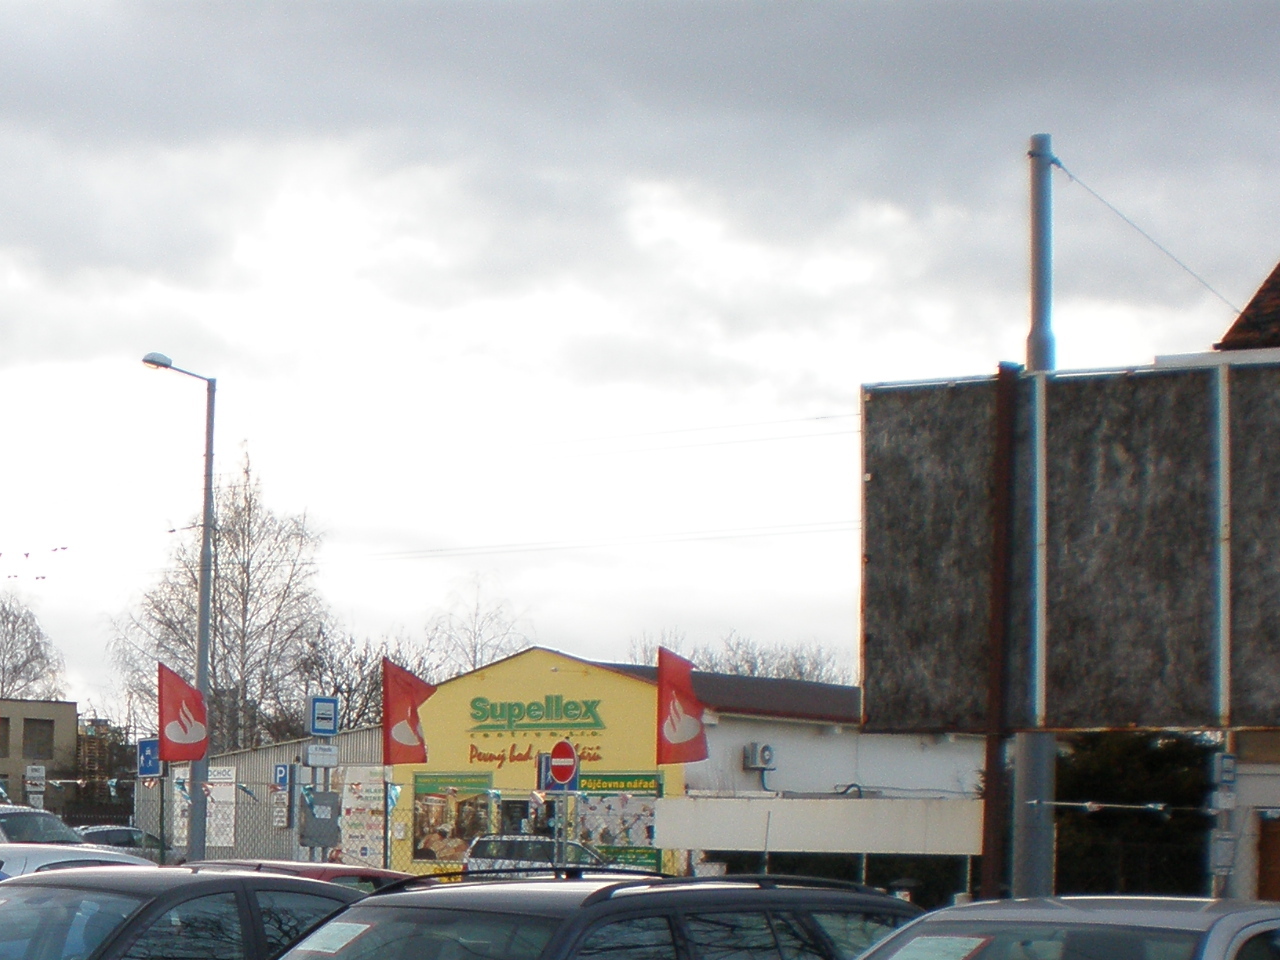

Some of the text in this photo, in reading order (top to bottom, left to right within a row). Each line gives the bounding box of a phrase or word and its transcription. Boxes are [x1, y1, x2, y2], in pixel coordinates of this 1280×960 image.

[470, 695, 602, 729] Supellex
[276, 766, 286, 783] P
[580, 779, 625, 790] Půjčovna
